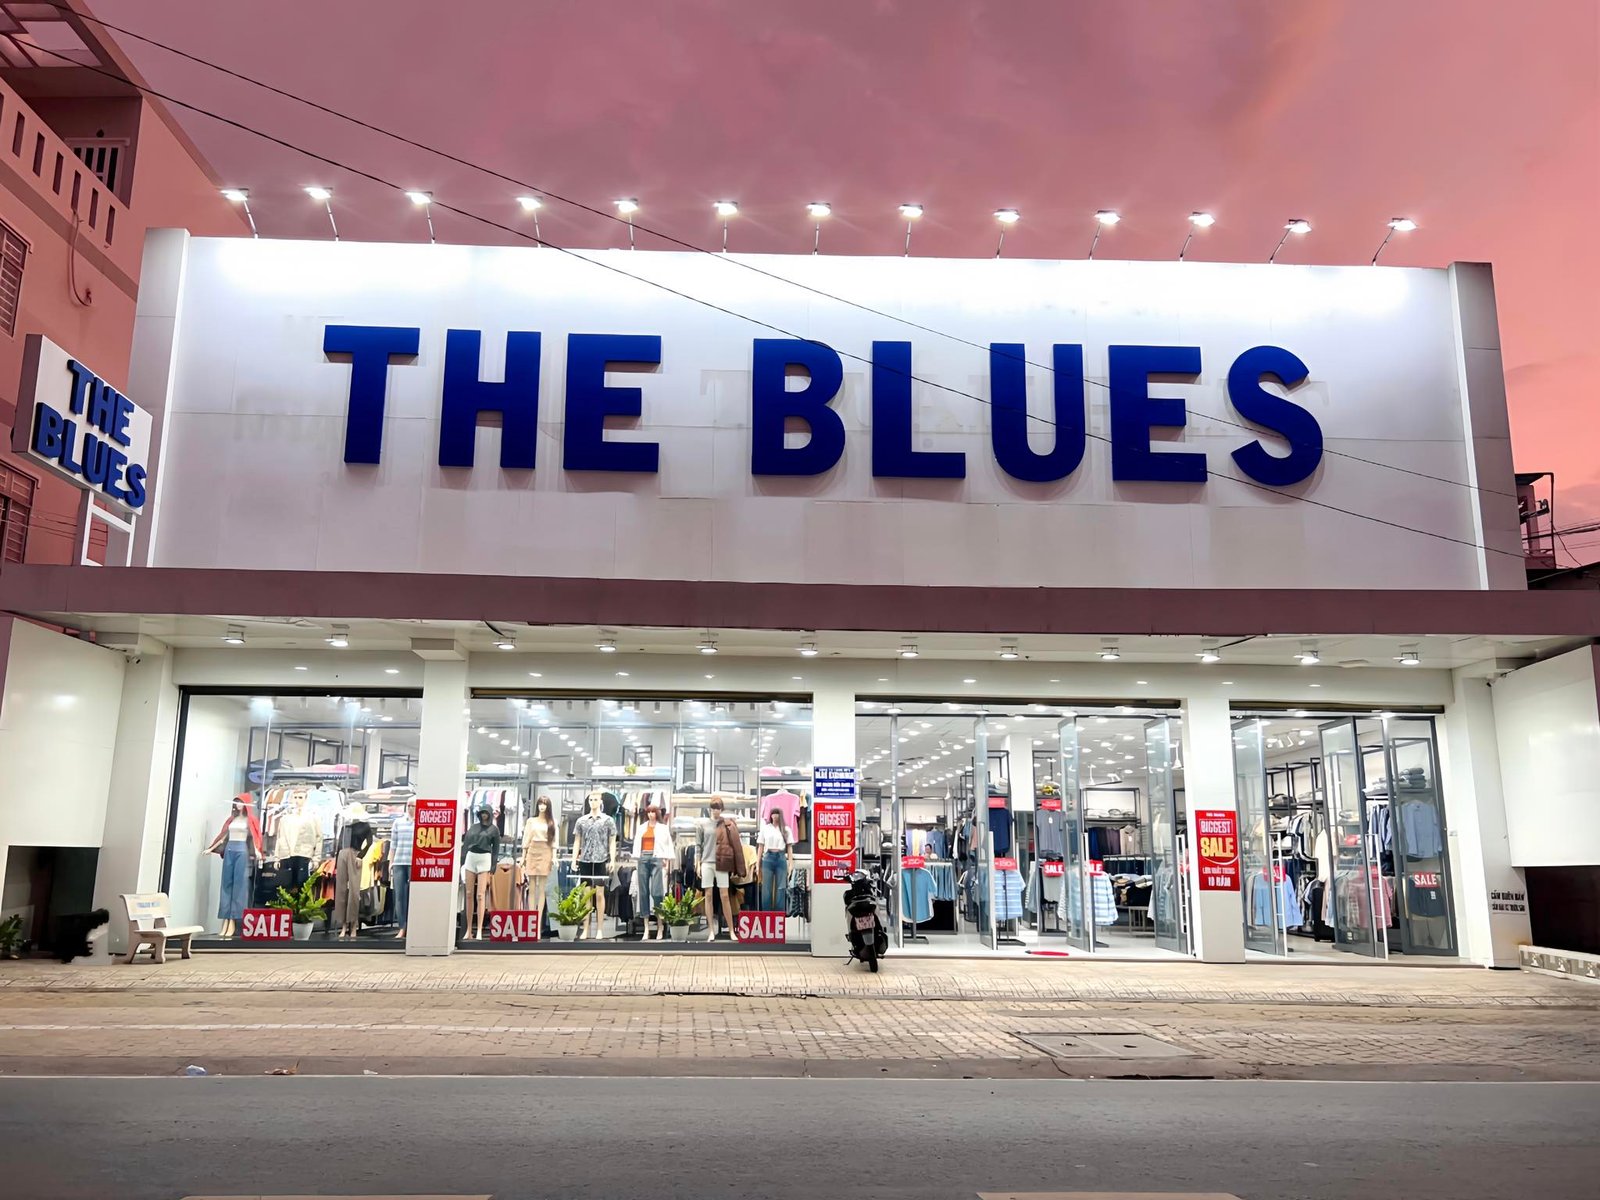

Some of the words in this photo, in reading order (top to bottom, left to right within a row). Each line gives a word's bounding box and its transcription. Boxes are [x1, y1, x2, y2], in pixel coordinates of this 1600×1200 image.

[66, 359, 134, 447] THE
[324, 325, 661, 473] THE
[751, 339, 1323, 486] BLUES
[32, 402, 147, 508] BLUES
[420, 810, 452, 823] BIGGEST
[819, 812, 850, 826] BIGGEST
[1200, 820, 1231, 833] BIGGEST
[416, 827, 452, 848] SALE
[817, 829, 852, 850] SALE
[1200, 837, 1235, 857] SALE
[1044, 864, 1064, 874] SALE
[1414, 873, 1438, 885] SALE
[242, 913, 290, 937] SALE
[490, 914, 537, 938] SALE
[739, 915, 784, 939] SALE
